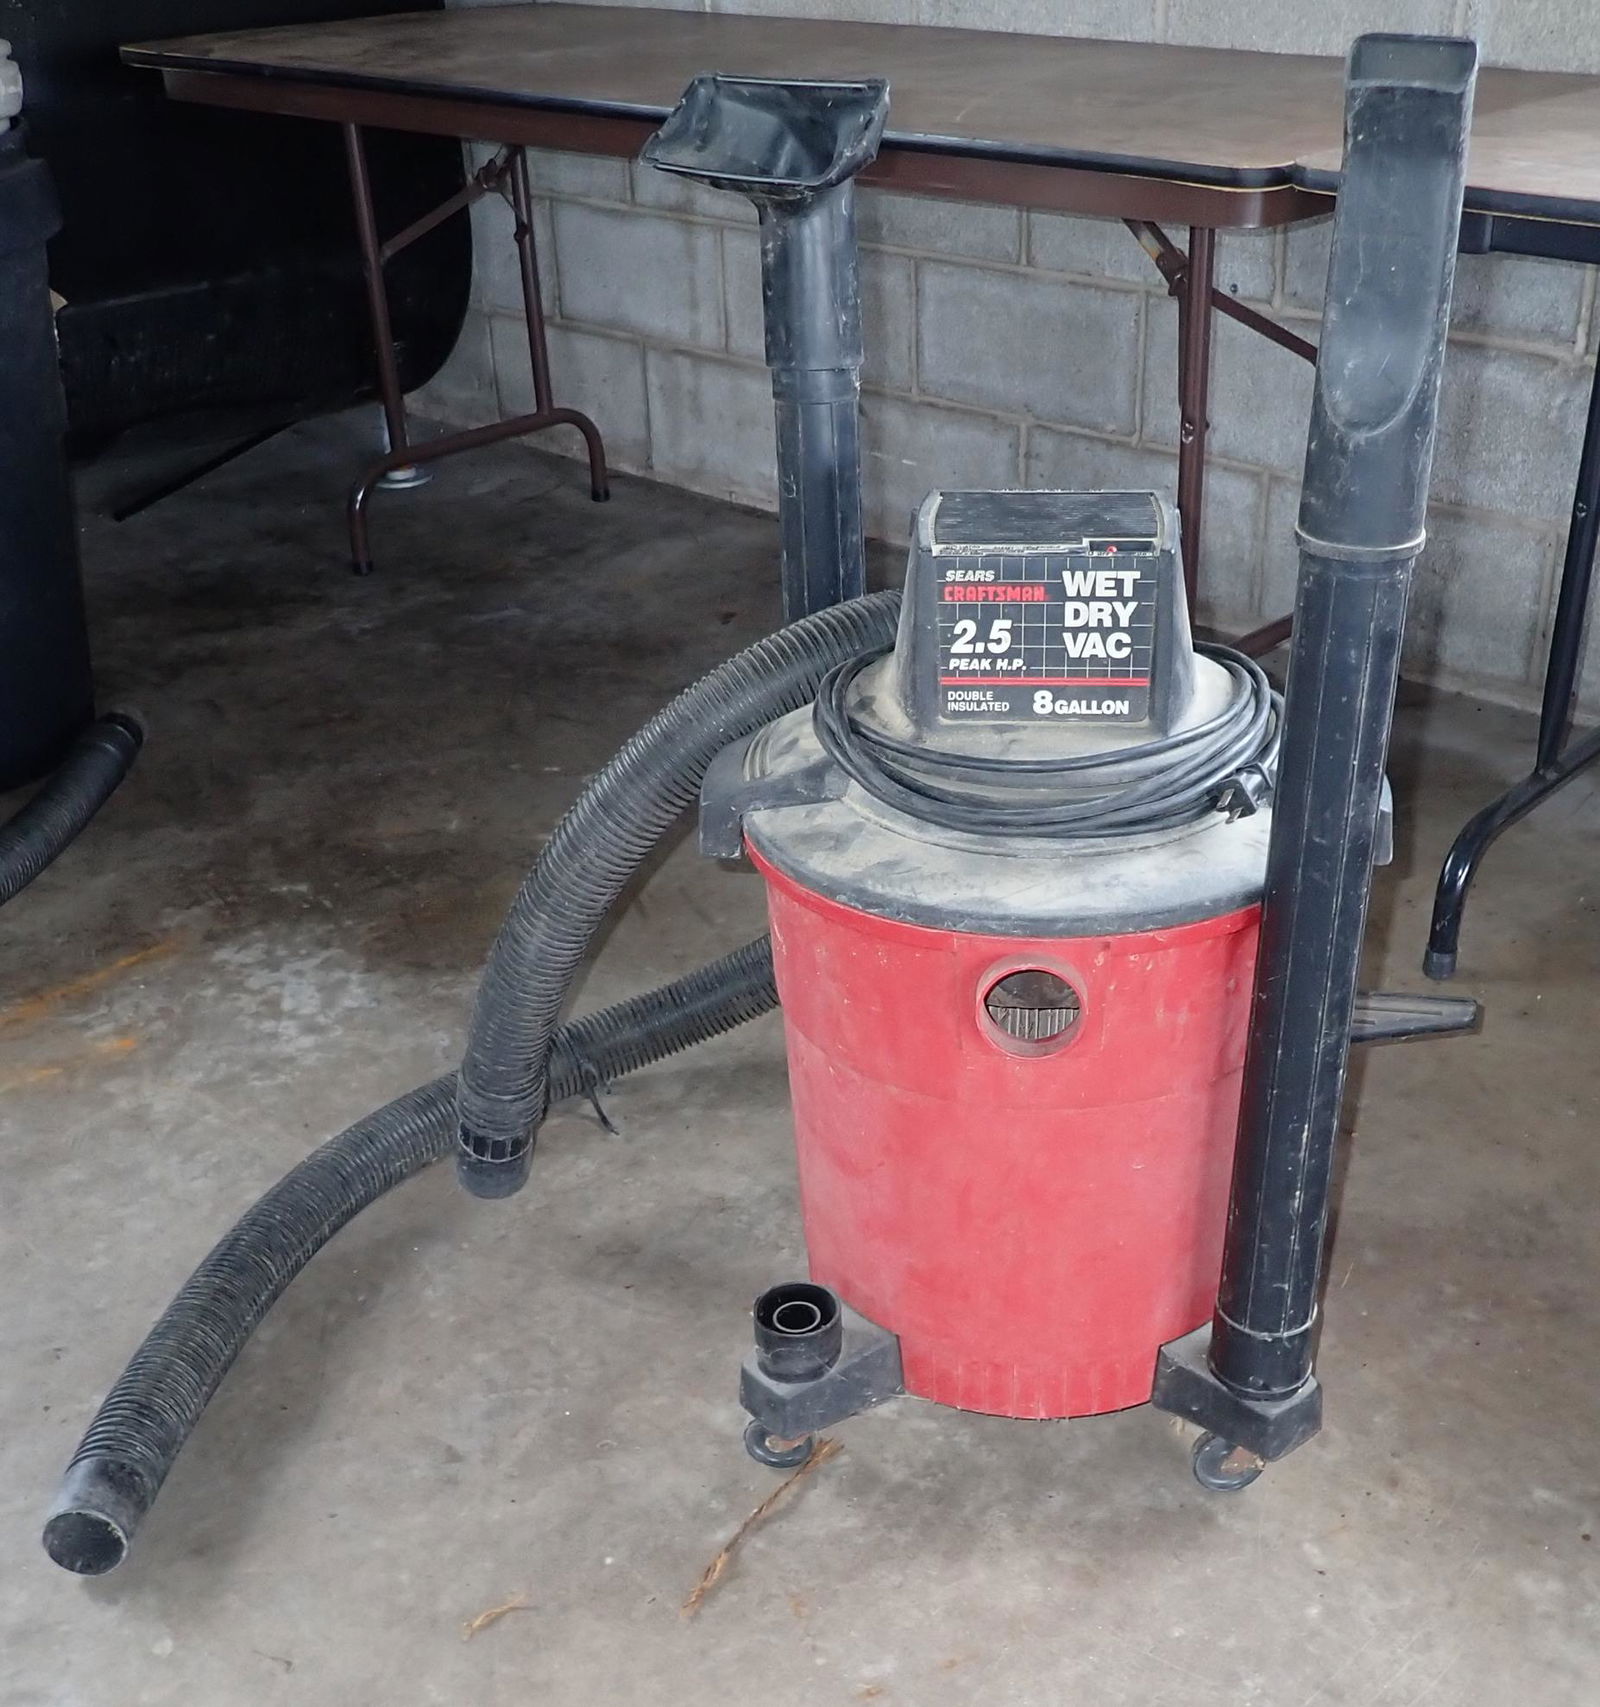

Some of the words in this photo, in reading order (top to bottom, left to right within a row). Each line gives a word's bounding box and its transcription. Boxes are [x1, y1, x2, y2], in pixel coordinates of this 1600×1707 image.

[945, 570, 995, 582] SEARS
[1062, 571, 1141, 597] WET
[944, 586, 1045, 602] CRAFTSMAN
[1064, 602, 1138, 628] DRY
[950, 620, 1012, 654] 2.5
[1062, 632, 1132, 658] VAC
[949, 659, 992, 671] PEAK
[996, 659, 1027, 671] H.P.
[947, 691, 994, 701] DOUBLE
[1032, 690, 1053, 714] 8
[1054, 700, 1129, 715] GALLON
[947, 702, 1010, 712] INSULATED
